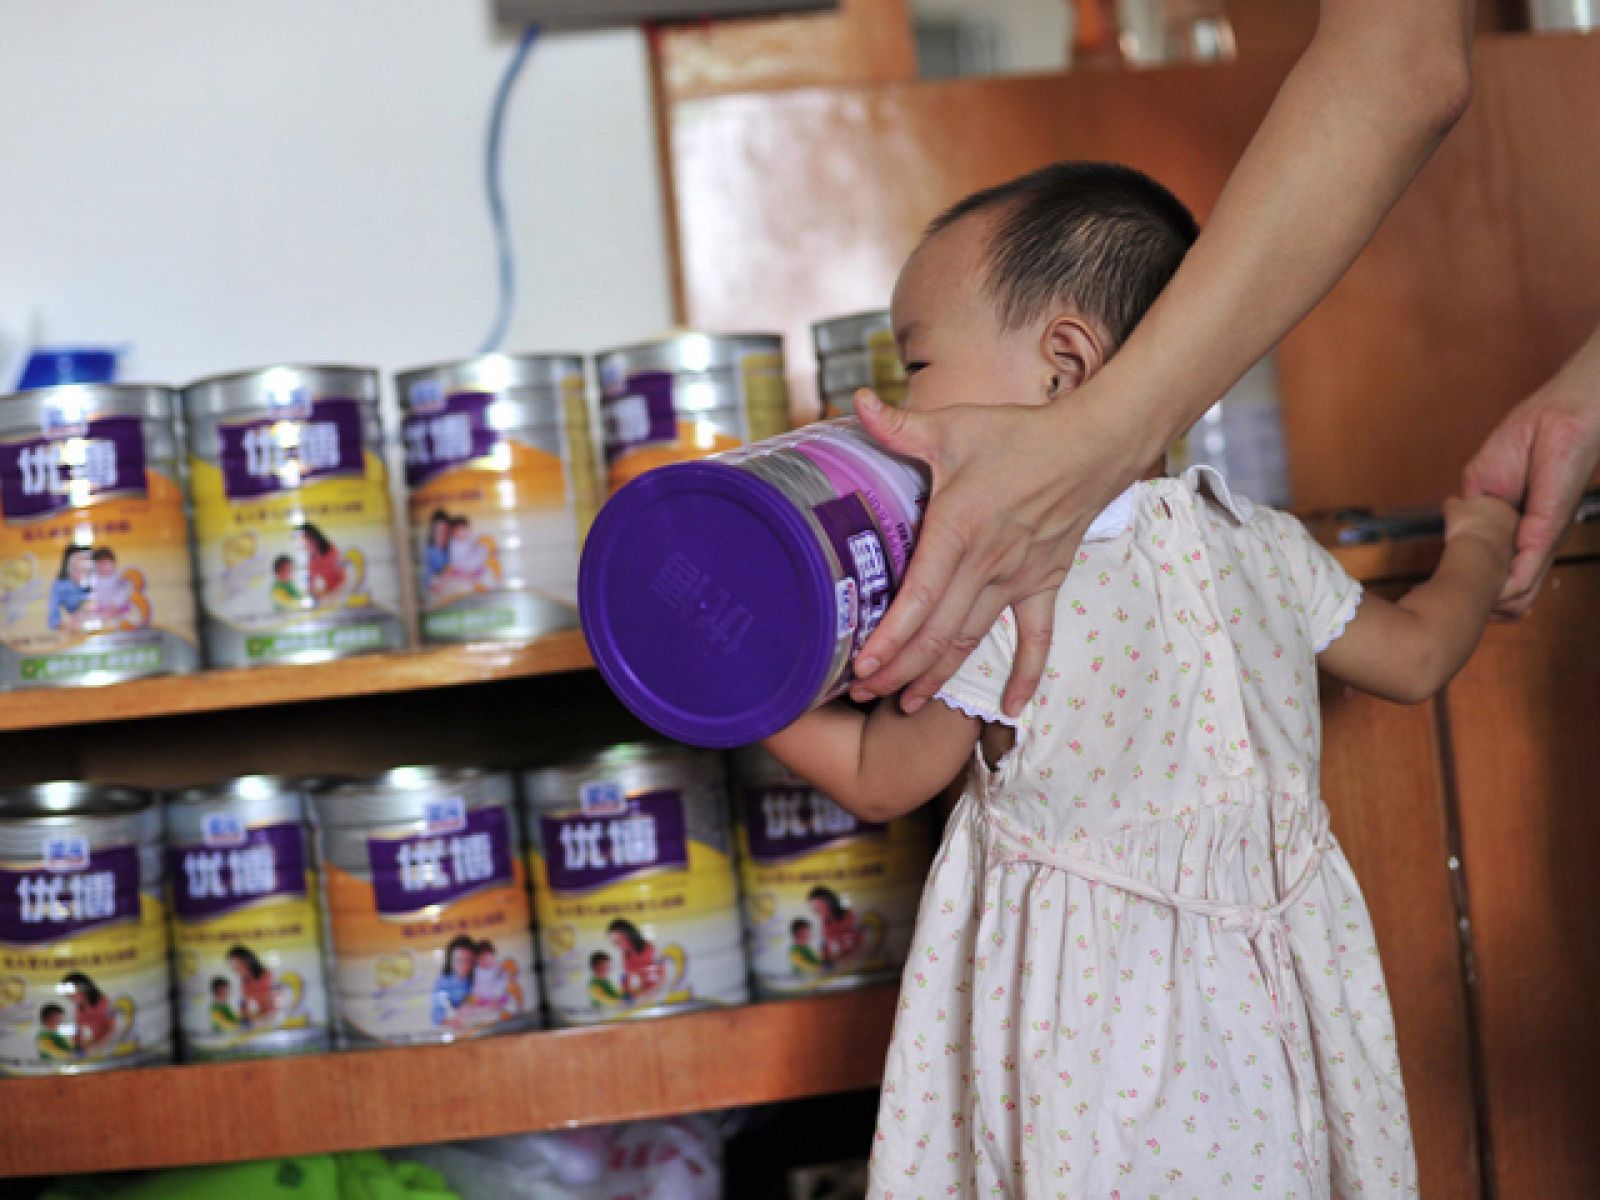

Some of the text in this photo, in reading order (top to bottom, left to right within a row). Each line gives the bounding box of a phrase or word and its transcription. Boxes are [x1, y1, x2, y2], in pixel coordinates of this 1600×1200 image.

[649, 552, 755, 655] 优博
[397, 832, 496, 892] 优博
[560, 815, 659, 870] 优博
[16, 871, 117, 923] 优博
[184, 844, 277, 898] 优博
